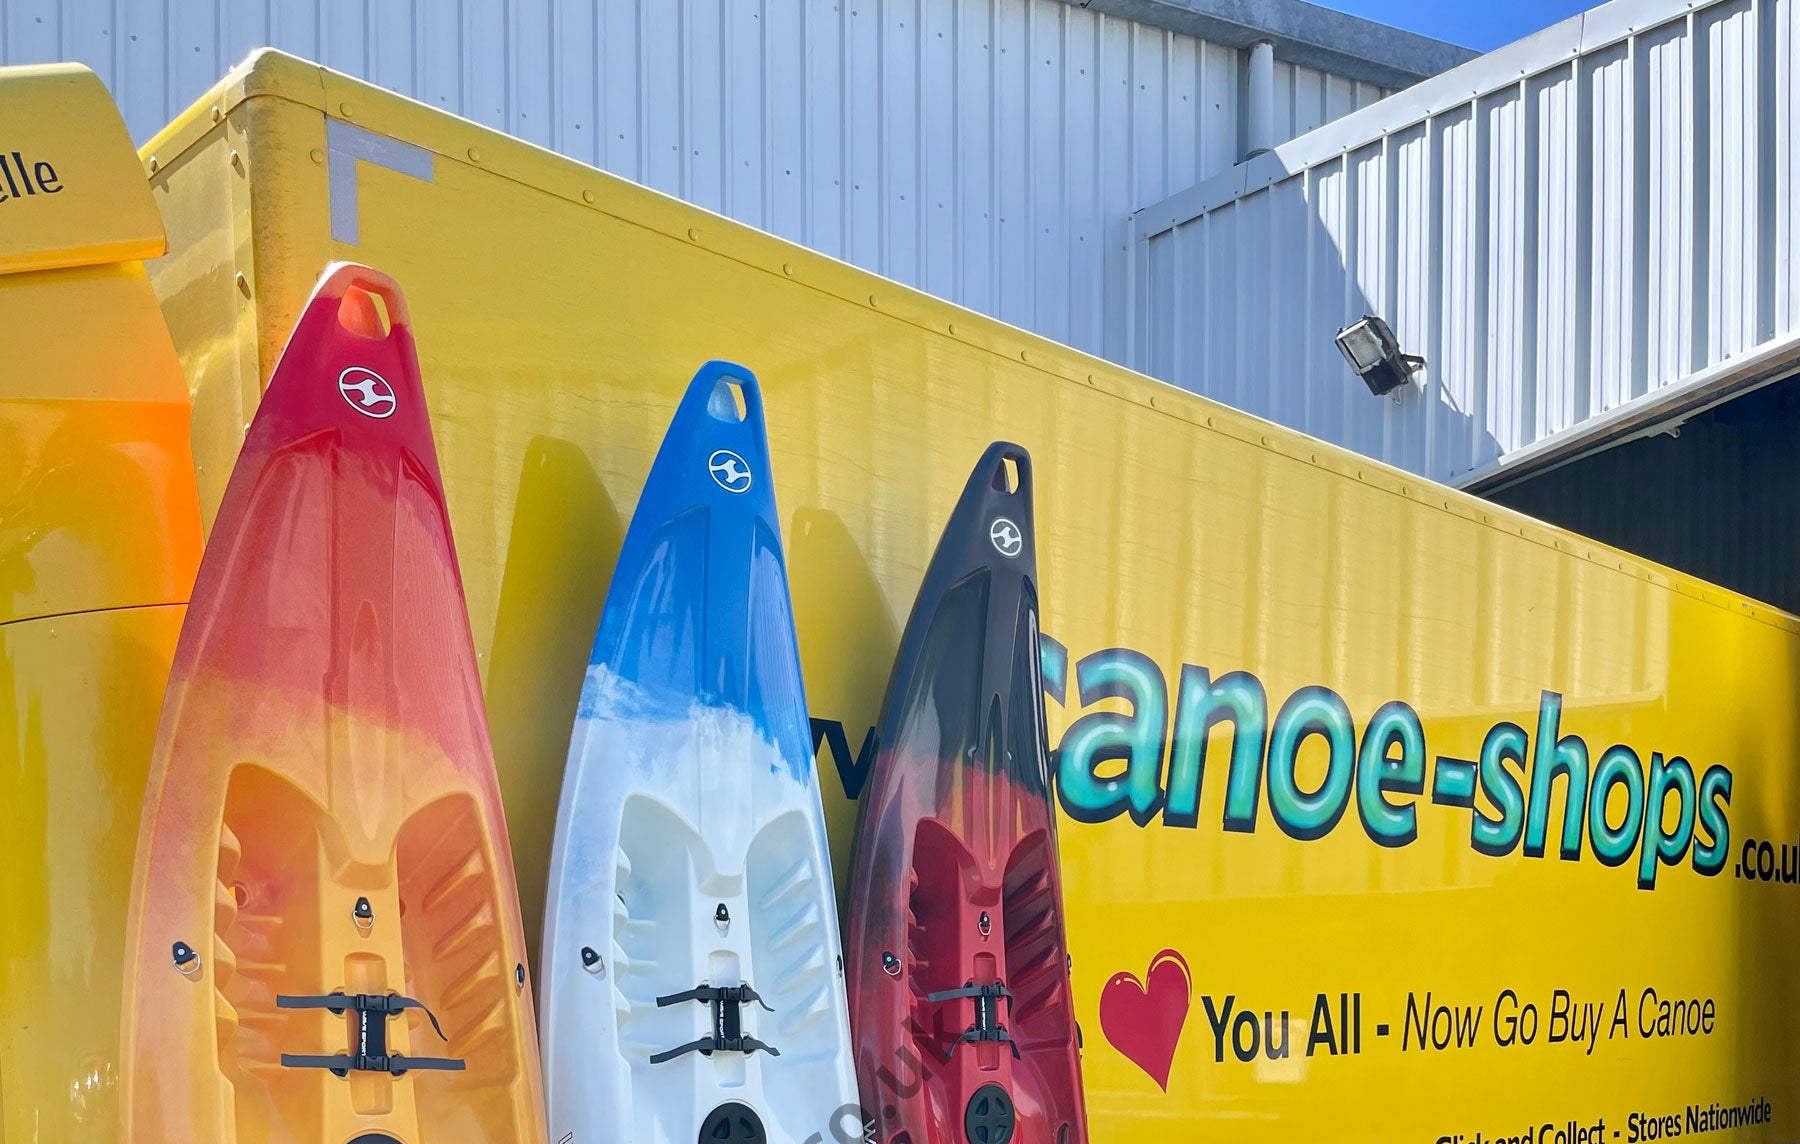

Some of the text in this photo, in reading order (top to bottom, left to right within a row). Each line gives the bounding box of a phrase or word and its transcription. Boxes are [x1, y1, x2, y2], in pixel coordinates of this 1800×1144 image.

[0, 151, 64, 204] lle
[1201, 995, 1290, 1063] You
[1306, 993, 1361, 1057] All
[1402, 991, 1484, 1052] Now
[1494, 989, 1538, 1047] Go
[1548, 989, 1604, 1056] Buy
[1609, 988, 1629, 1040] A
[1638, 987, 1716, 1039] Canoe
[1627, 1112, 1682, 1144] Stores
[1685, 1097, 1772, 1135] Nationwide
